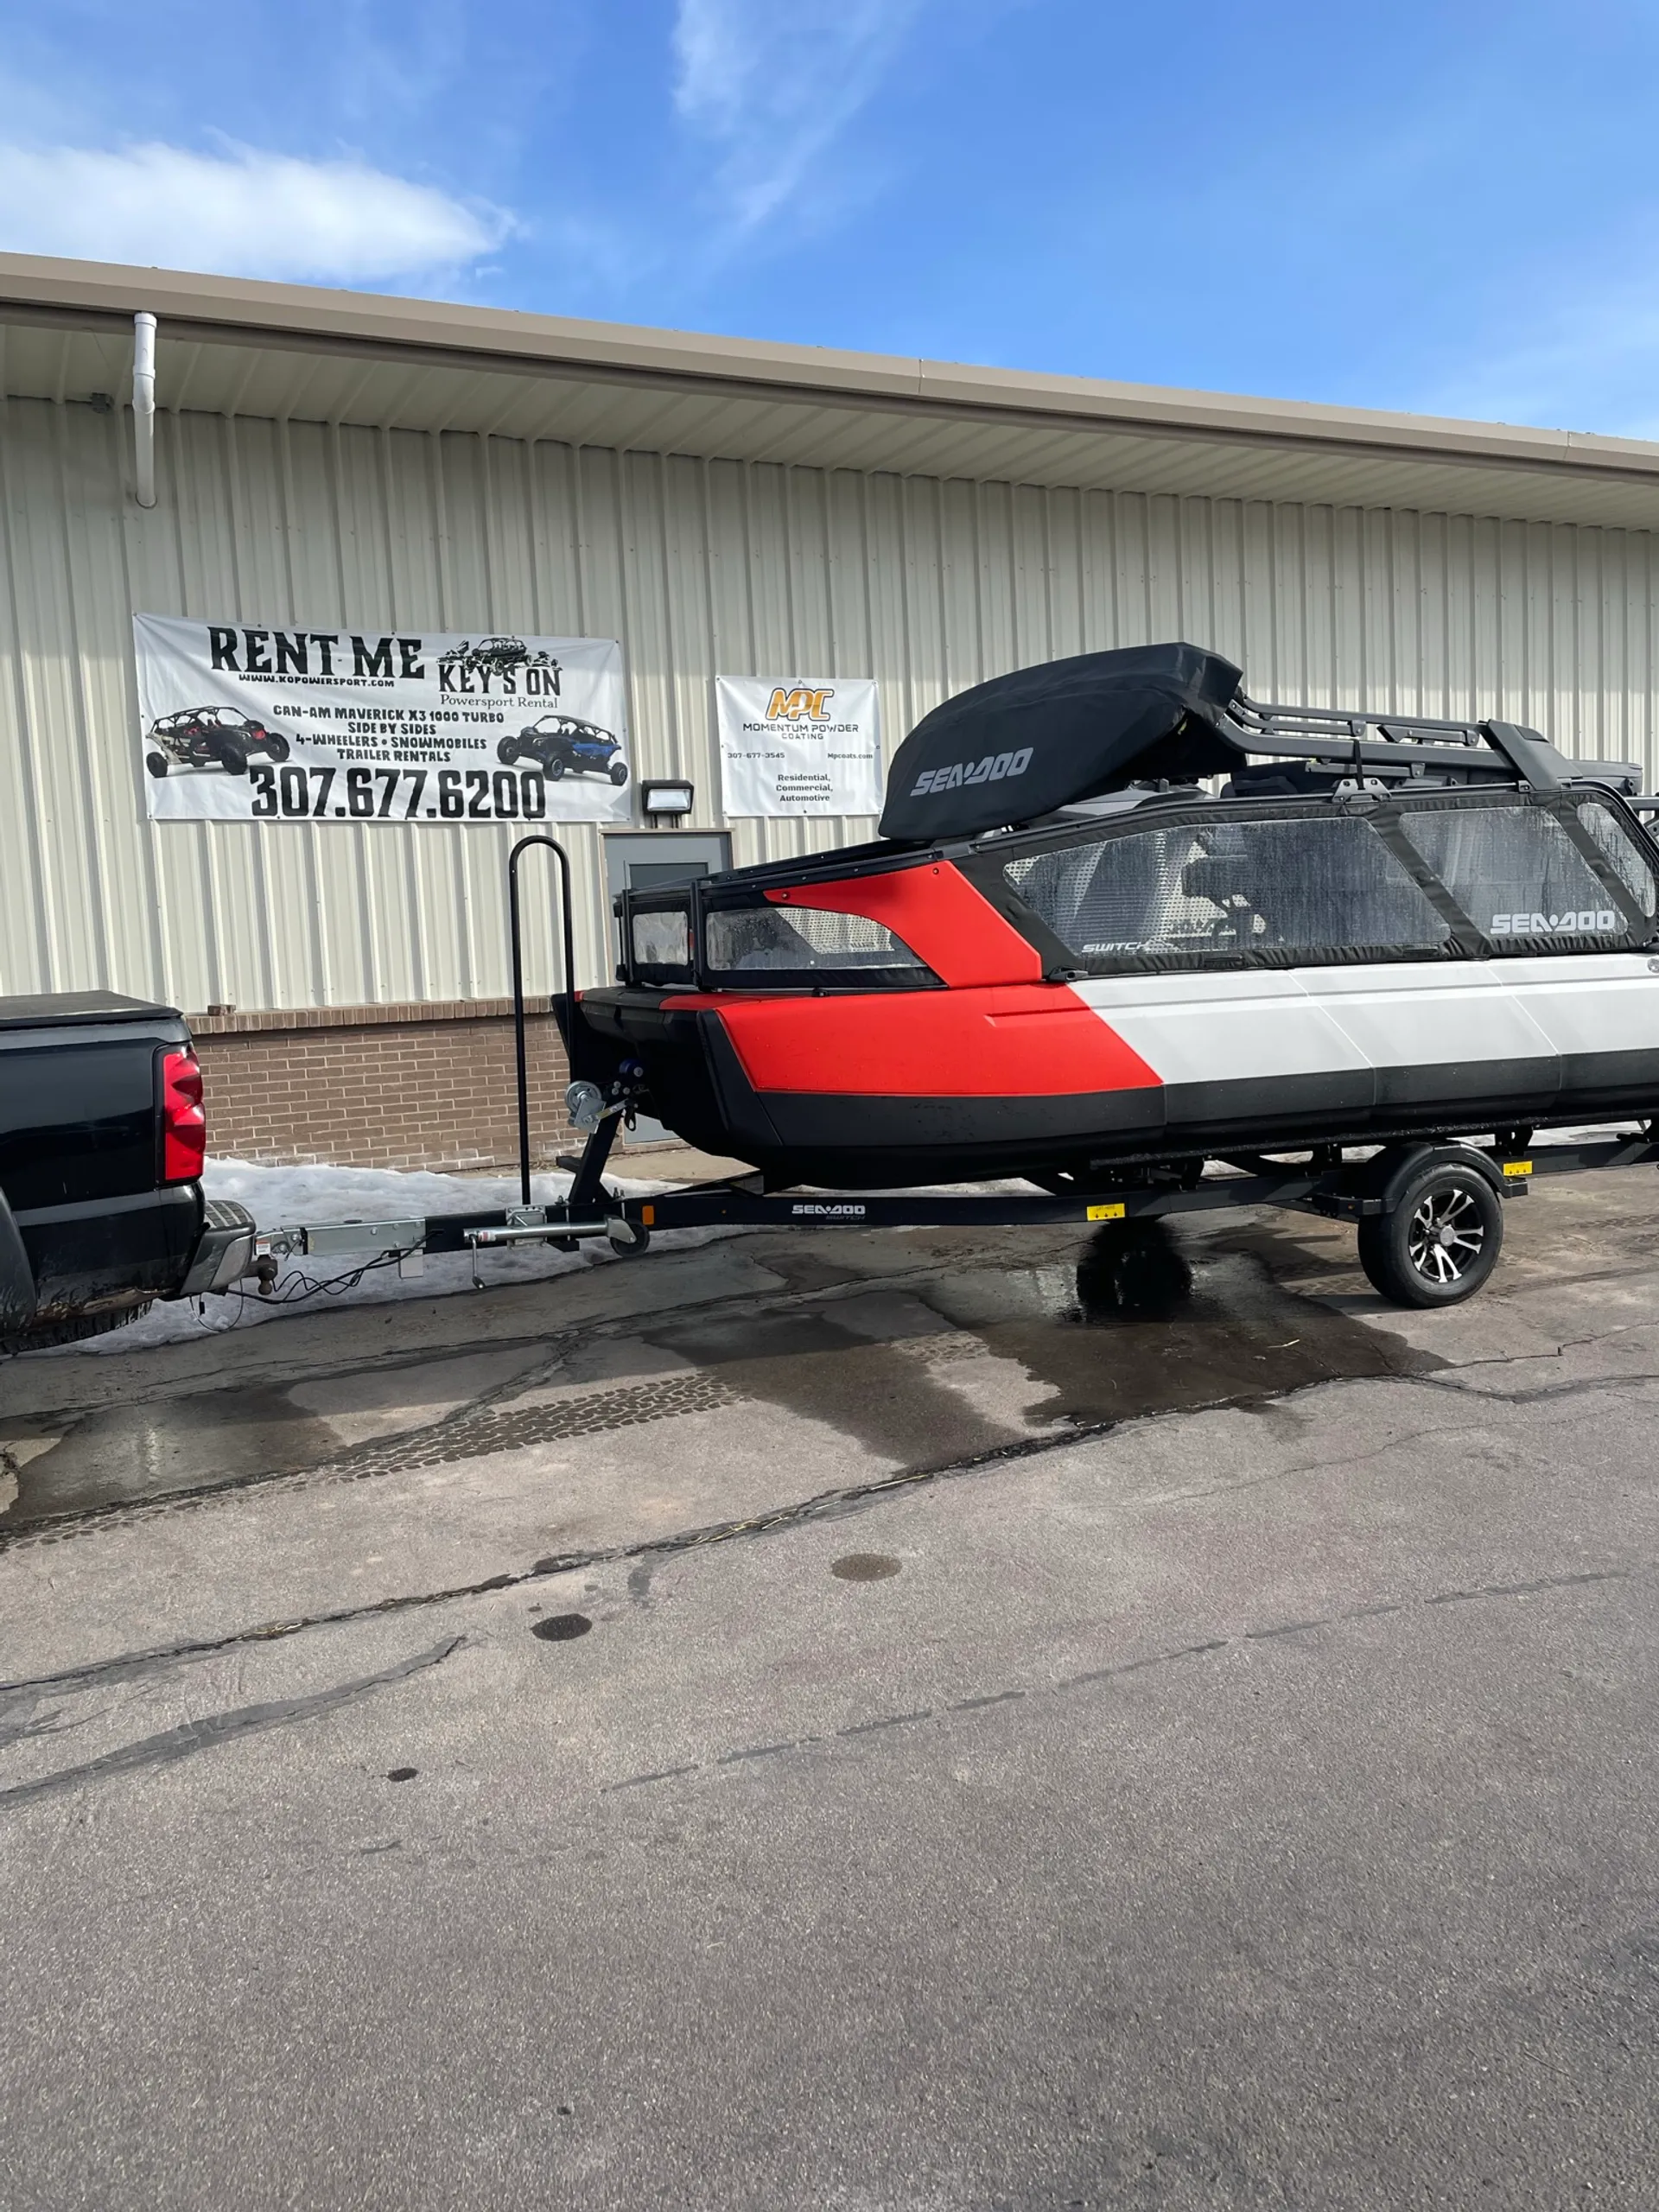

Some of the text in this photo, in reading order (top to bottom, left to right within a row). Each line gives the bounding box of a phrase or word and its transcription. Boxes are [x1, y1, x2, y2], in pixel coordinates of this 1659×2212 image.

[207, 626, 425, 679] RENT ME
[238, 674, 395, 687] WWW.KOPOWERSPORT.COM
[526, 668, 561, 696] ON
[441, 695, 558, 709] Powersport Rental
[766, 688, 835, 721] MPC
[273, 705, 331, 718] CAN-AM
[334, 708, 404, 721] MAVERICK
[409, 710, 427, 721] X3
[462, 712, 504, 723] TURBO
[348, 722, 436, 734] SIDE BY SIDES
[743, 723, 808, 732] MOMENTUM
[296, 734, 486, 749] 4-WHEELERS SNOWMOBILES
[337, 748, 451, 762] TRAILER RENTALS
[250, 766, 546, 819] 307.677.6200
[776, 784, 833, 792] Commercial,
